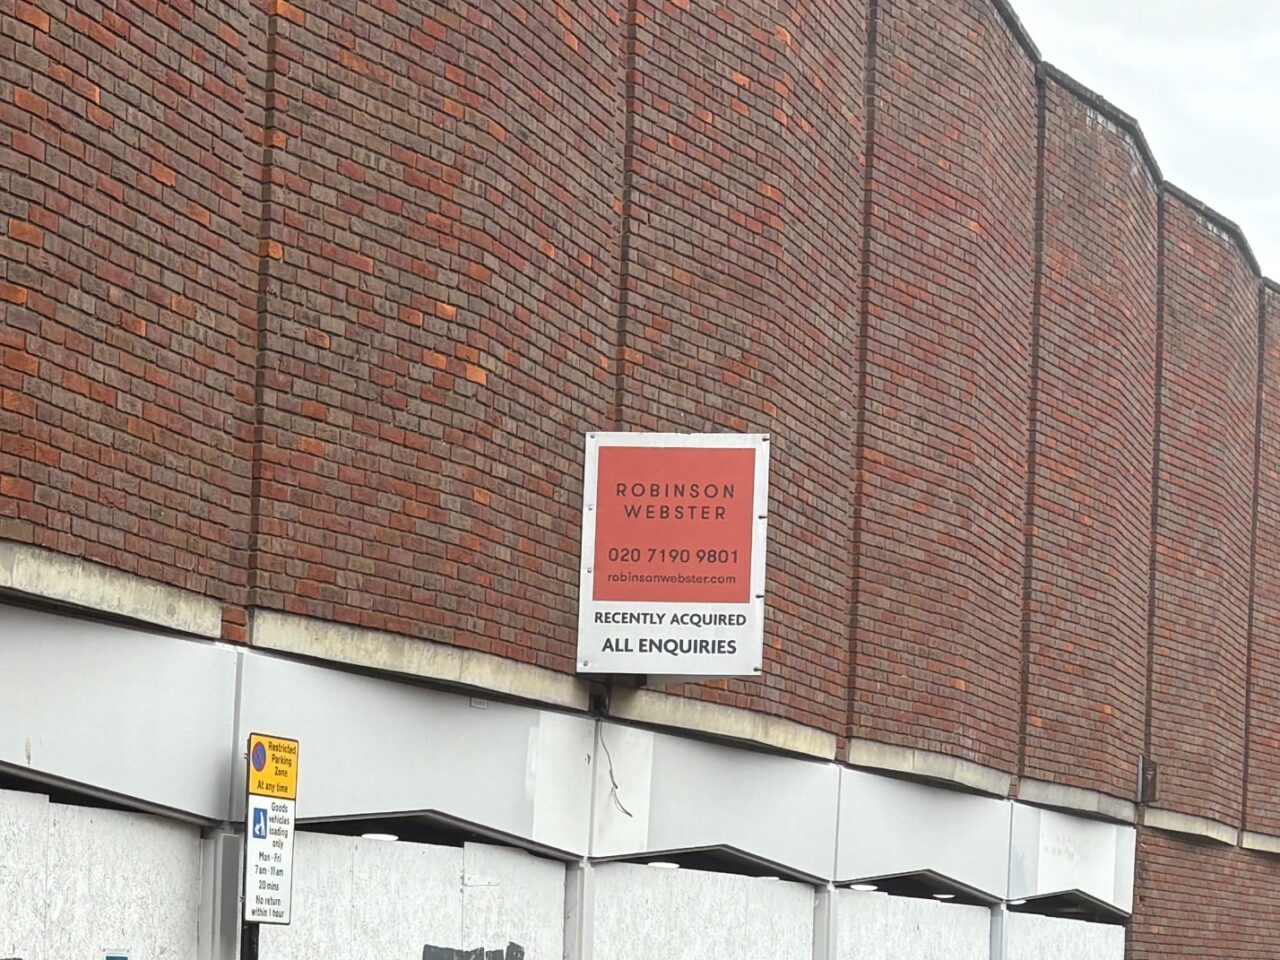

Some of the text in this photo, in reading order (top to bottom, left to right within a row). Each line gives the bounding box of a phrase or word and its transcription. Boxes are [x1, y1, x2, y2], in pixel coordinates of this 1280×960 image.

[616, 483, 735, 499] ROBINSON
[624, 505, 726, 520] WEBSTER
[608, 548, 738, 564] 020 7190 9801
[607, 572, 736, 585] robinsonwebster.com
[594, 611, 747, 628] RECENTLY ACQUIRED
[601, 637, 737, 656] ALL ENQUIRIES
[268, 741, 297, 755] Restricted
[272, 753, 292, 768] Parking
[274, 766, 289, 778] Zone
[257, 779, 289, 793] At any time
[271, 802, 288, 814] Goods
[268, 815, 290, 826] vehicles
[269, 825, 289, 839] loading
[272, 840, 284, 851] only
[258, 851, 270, 862] Mon
[274, 853, 282, 863] Fri
[258, 880, 280, 891] 20 mins
[255, 894, 281, 906] No return
[251, 907, 268, 917] within
[272, 908, 285, 918] hour
